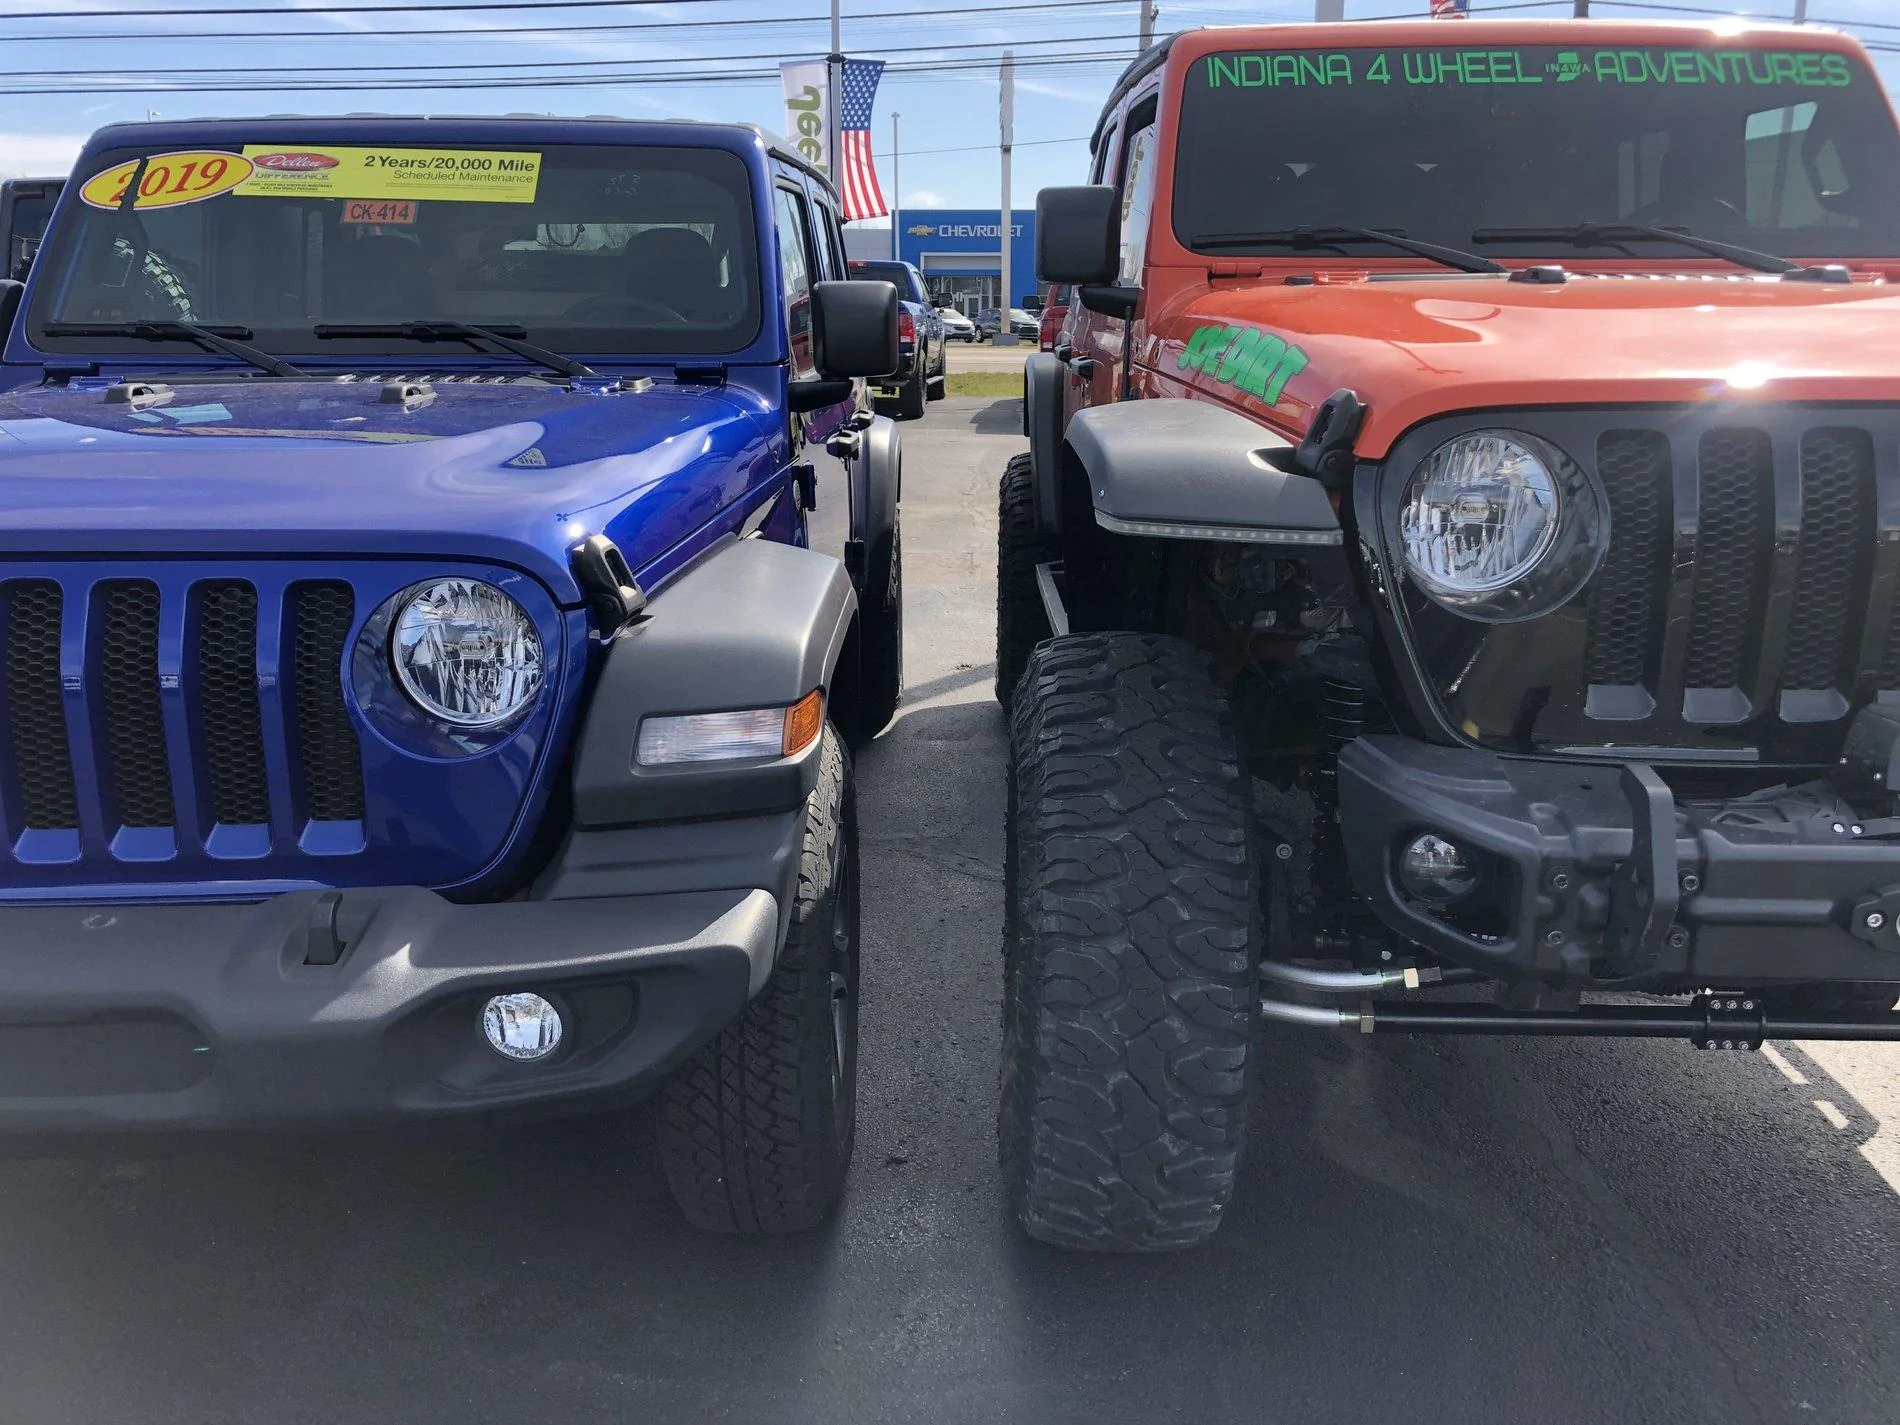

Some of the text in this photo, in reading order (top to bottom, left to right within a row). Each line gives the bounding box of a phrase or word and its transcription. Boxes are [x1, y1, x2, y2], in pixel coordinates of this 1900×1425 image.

[1207, 51, 1852, 88] INDIANA 4 WHEEL ADVENTURES
[1545, 63, 1591, 73] IN4WA
[266, 155, 324, 168] Dellen
[363, 155, 376, 167] 2
[497, 159, 535, 171] Mile
[108, 158, 229, 203] 2019
[393, 170, 533, 183] Scheduled Maintenance
[350, 203, 410, 221] CK-414
